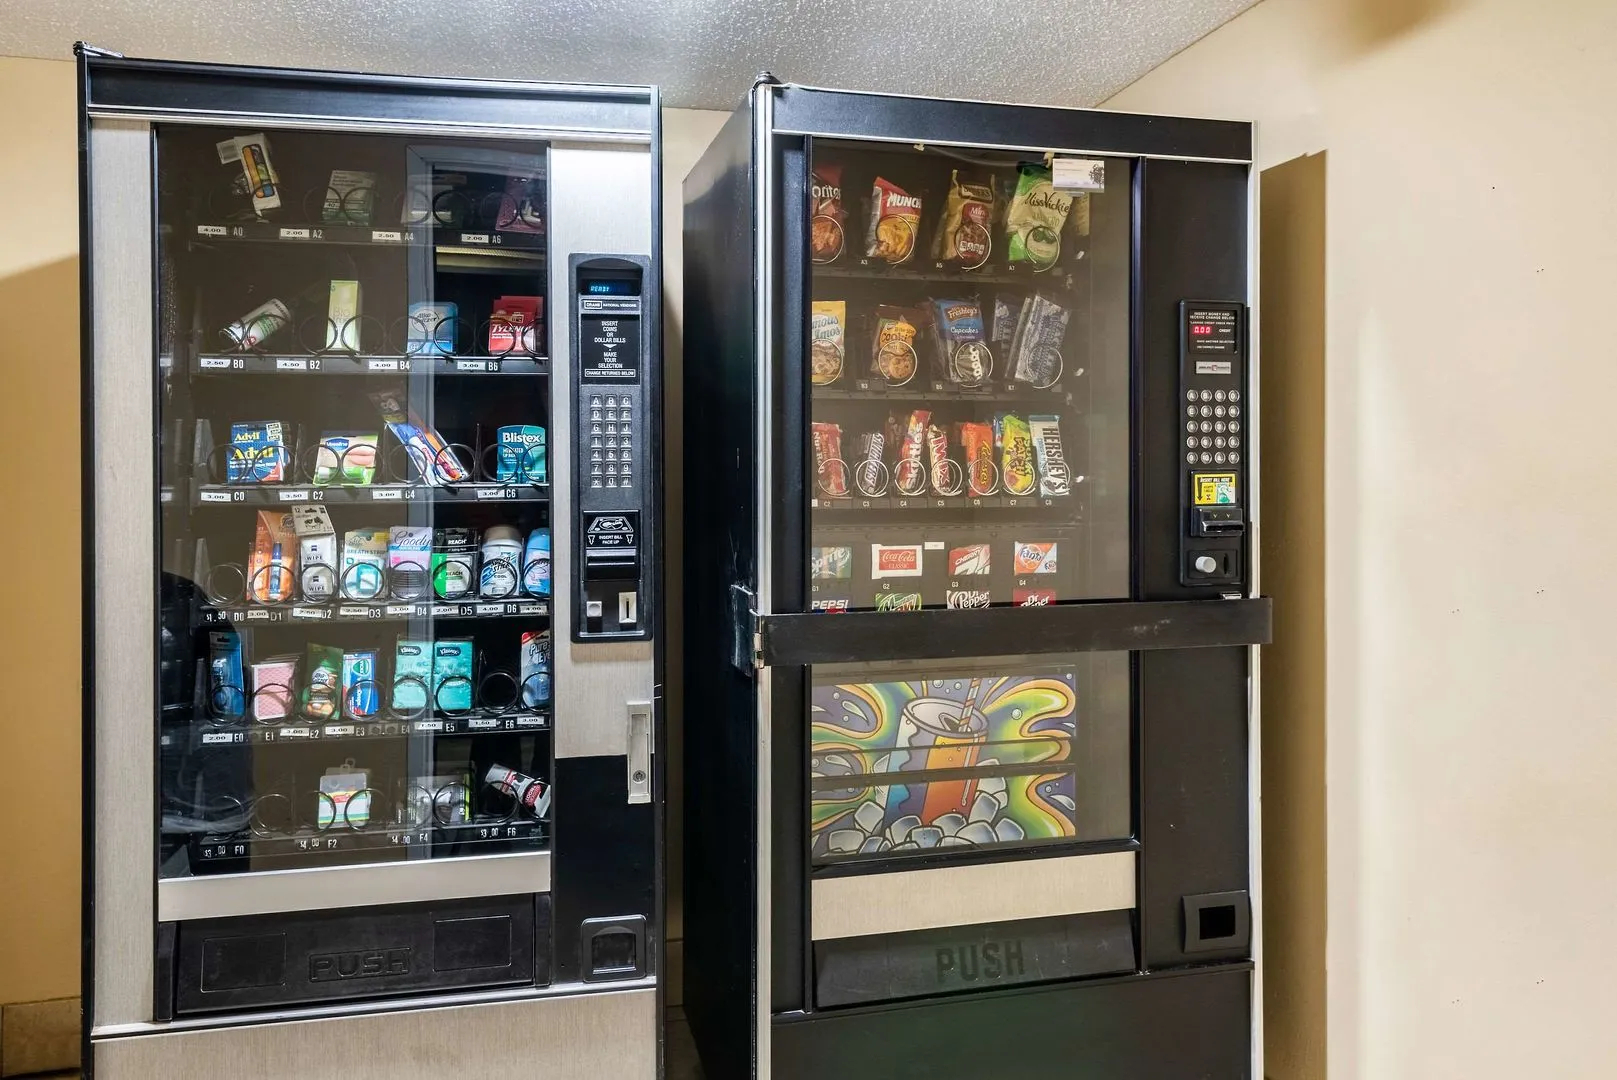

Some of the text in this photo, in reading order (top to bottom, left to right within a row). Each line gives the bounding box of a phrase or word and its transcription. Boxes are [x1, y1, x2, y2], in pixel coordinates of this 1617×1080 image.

[1025, 193, 1044, 207] Miss
[233, 227, 243, 236] A0
[312, 230, 322, 239] A2
[404, 232, 414, 241] A4
[492, 235, 501, 244] A6
[492, 324, 532, 333] TYLEN
[233, 360, 244, 369] B0
[310, 360, 320, 370] B2
[400, 362, 410, 370] B4
[488, 362, 498, 371] B6
[234, 432, 260, 441] Advil
[502, 432, 540, 445] Blistex
[906, 422, 924, 489] Skittles
[1042, 428, 1068, 491] HERSHEY'S
[234, 492, 244, 500] C0
[313, 491, 323, 500] C2
[405, 490, 415, 499] C4
[506, 489, 516, 497] C6
[812, 600, 848, 609] PEPSI
[960, 592, 990, 608] Pepper
[270, 612, 282, 621] D1
[322, 609, 331, 618] D2
[369, 609, 381, 618] D3
[461, 606, 472, 615] D5
[507, 604, 516, 613] D6
[266, 732, 274, 740] E1
[310, 730, 319, 738] E2
[356, 728, 365, 736] E3
[401, 725, 410, 733] E4
[446, 723, 455, 732] E5
[506, 720, 514, 728] E6
[234, 733, 243, 742] E0
[507, 827, 516, 836] F6
[419, 833, 428, 842] F4
[328, 839, 337, 848] F2
[235, 845, 244, 855] F0
[311, 949, 409, 980] PUSH
[935, 940, 1025, 984] PUSH
